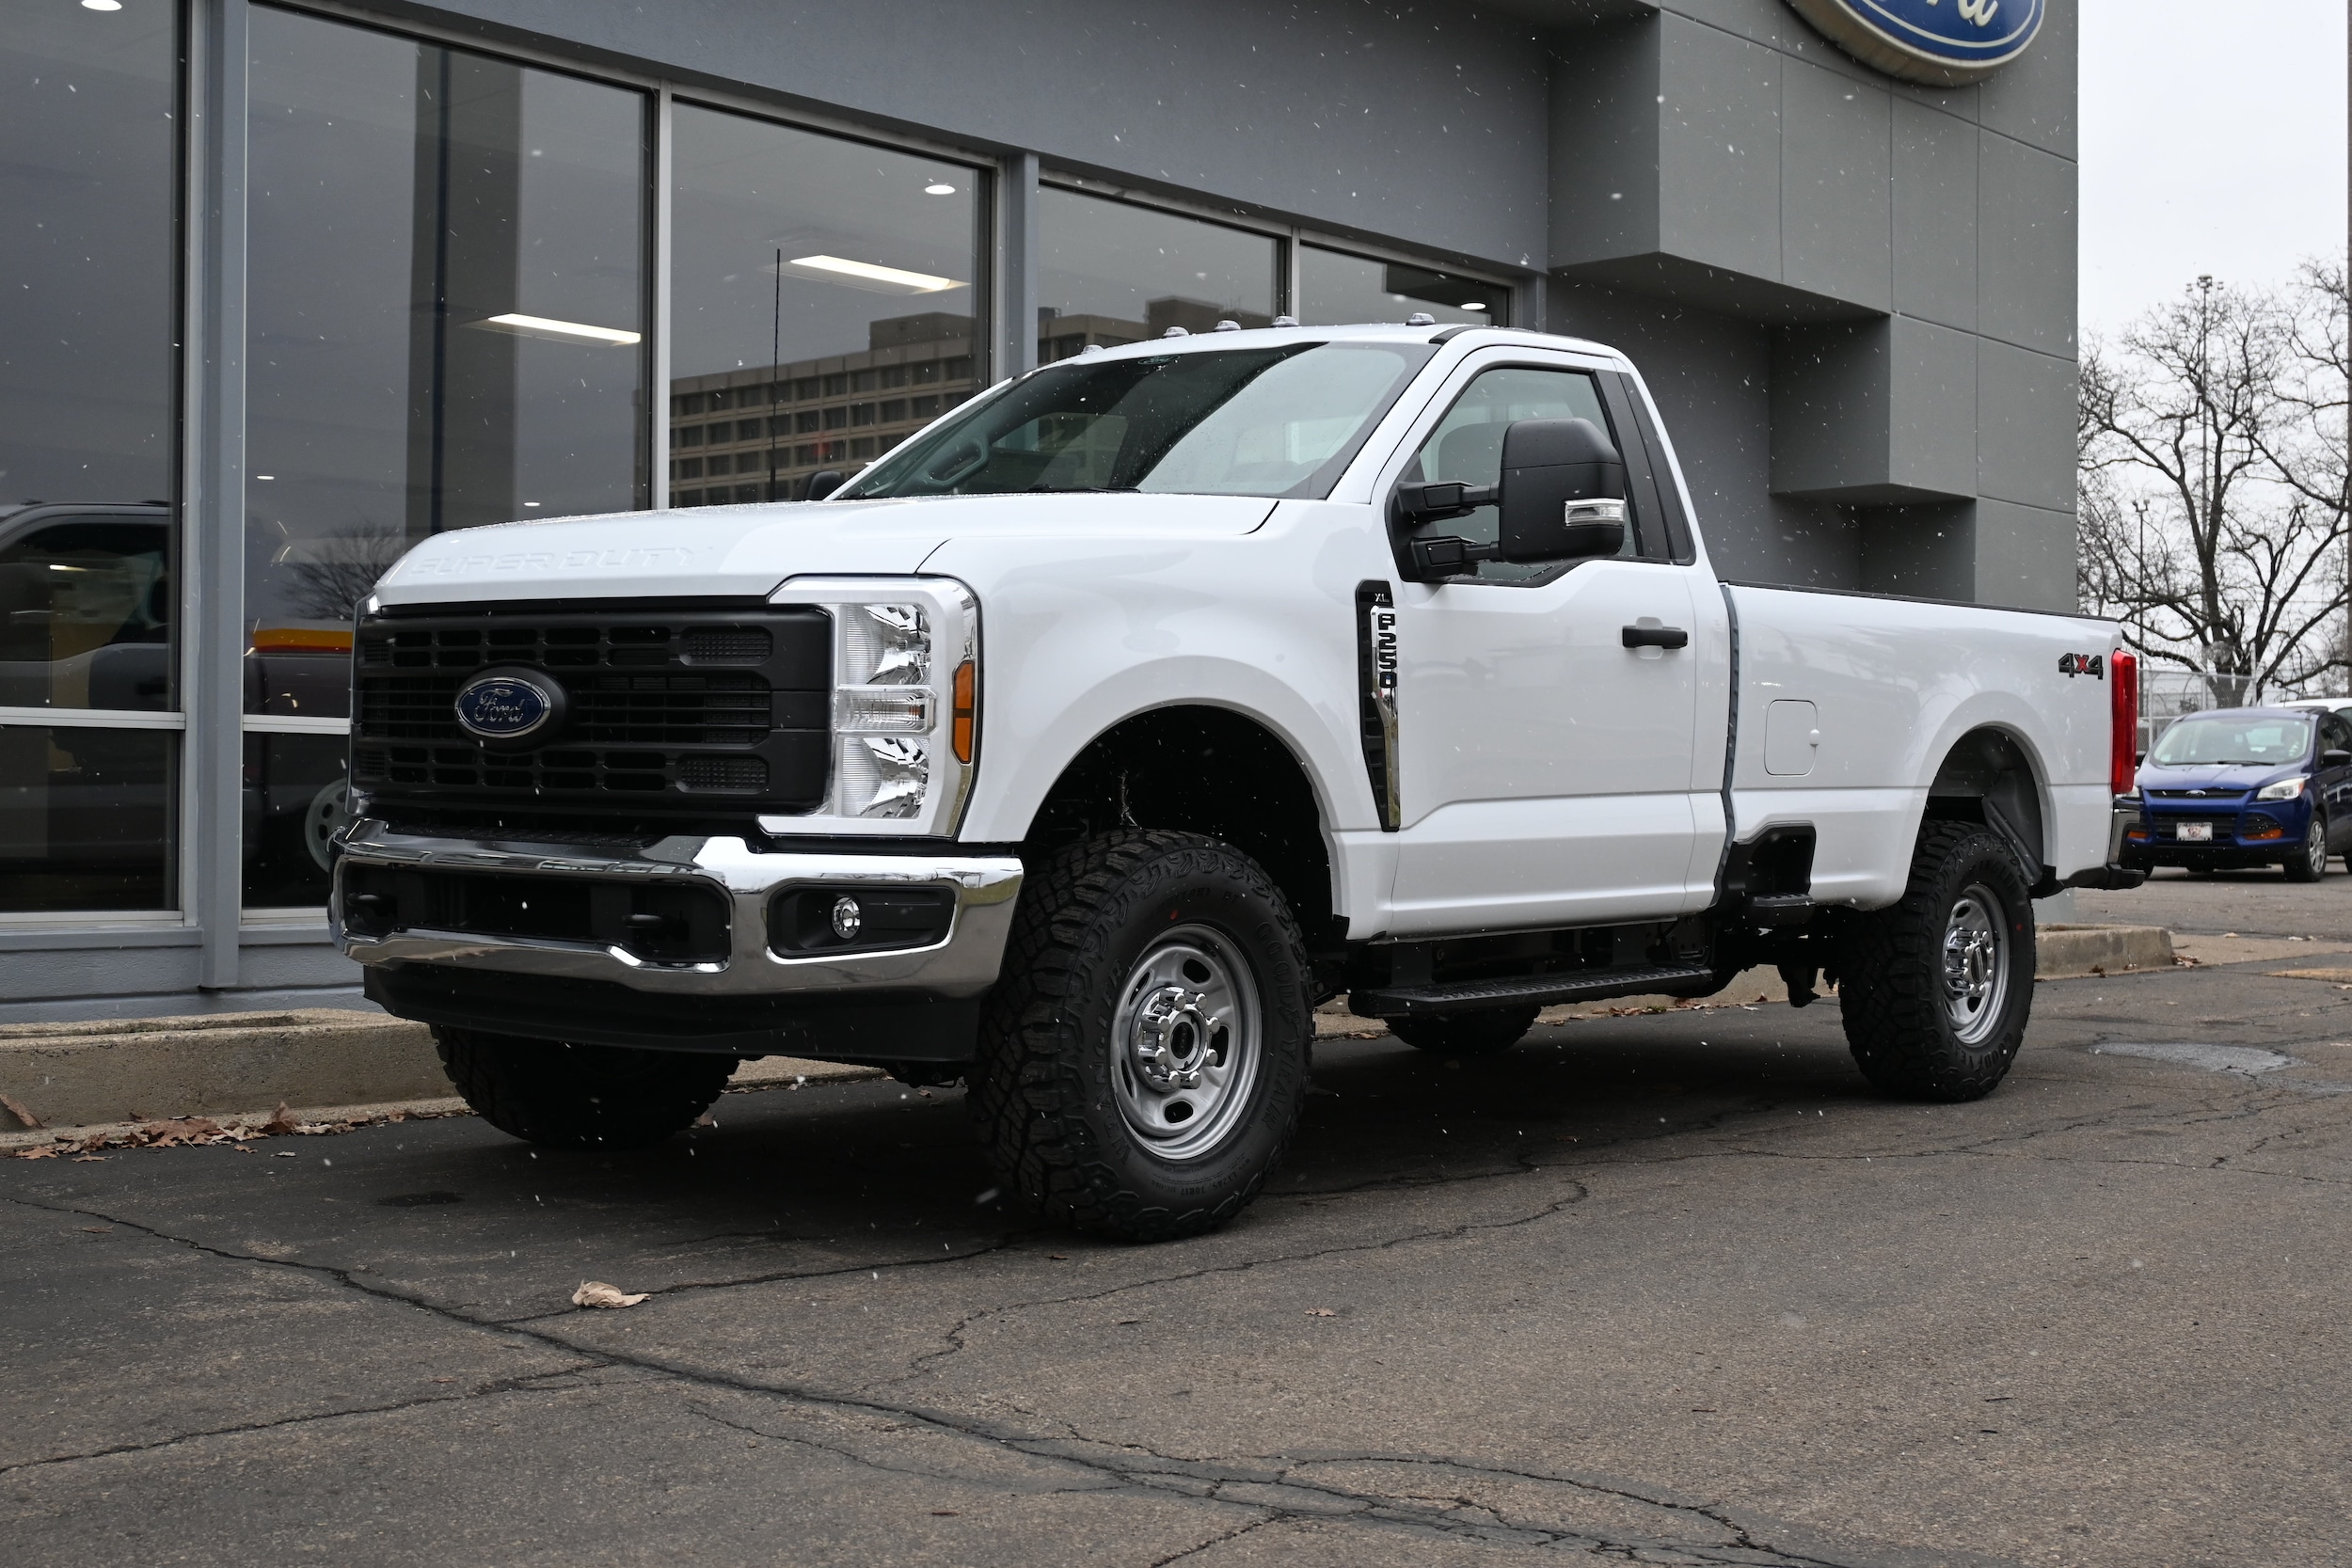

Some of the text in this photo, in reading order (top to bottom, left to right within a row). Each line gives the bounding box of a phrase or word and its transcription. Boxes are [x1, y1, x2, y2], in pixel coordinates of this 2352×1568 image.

[407, 546, 694, 577] SUPER DUTY
[1374, 593, 1391, 603] XL
[1377, 612, 1398, 689] F250
[473, 688, 526, 723] Ford
[1256, 921, 1299, 1131] GOODYEAR
[1093, 958, 1131, 1166] WRANGLER
